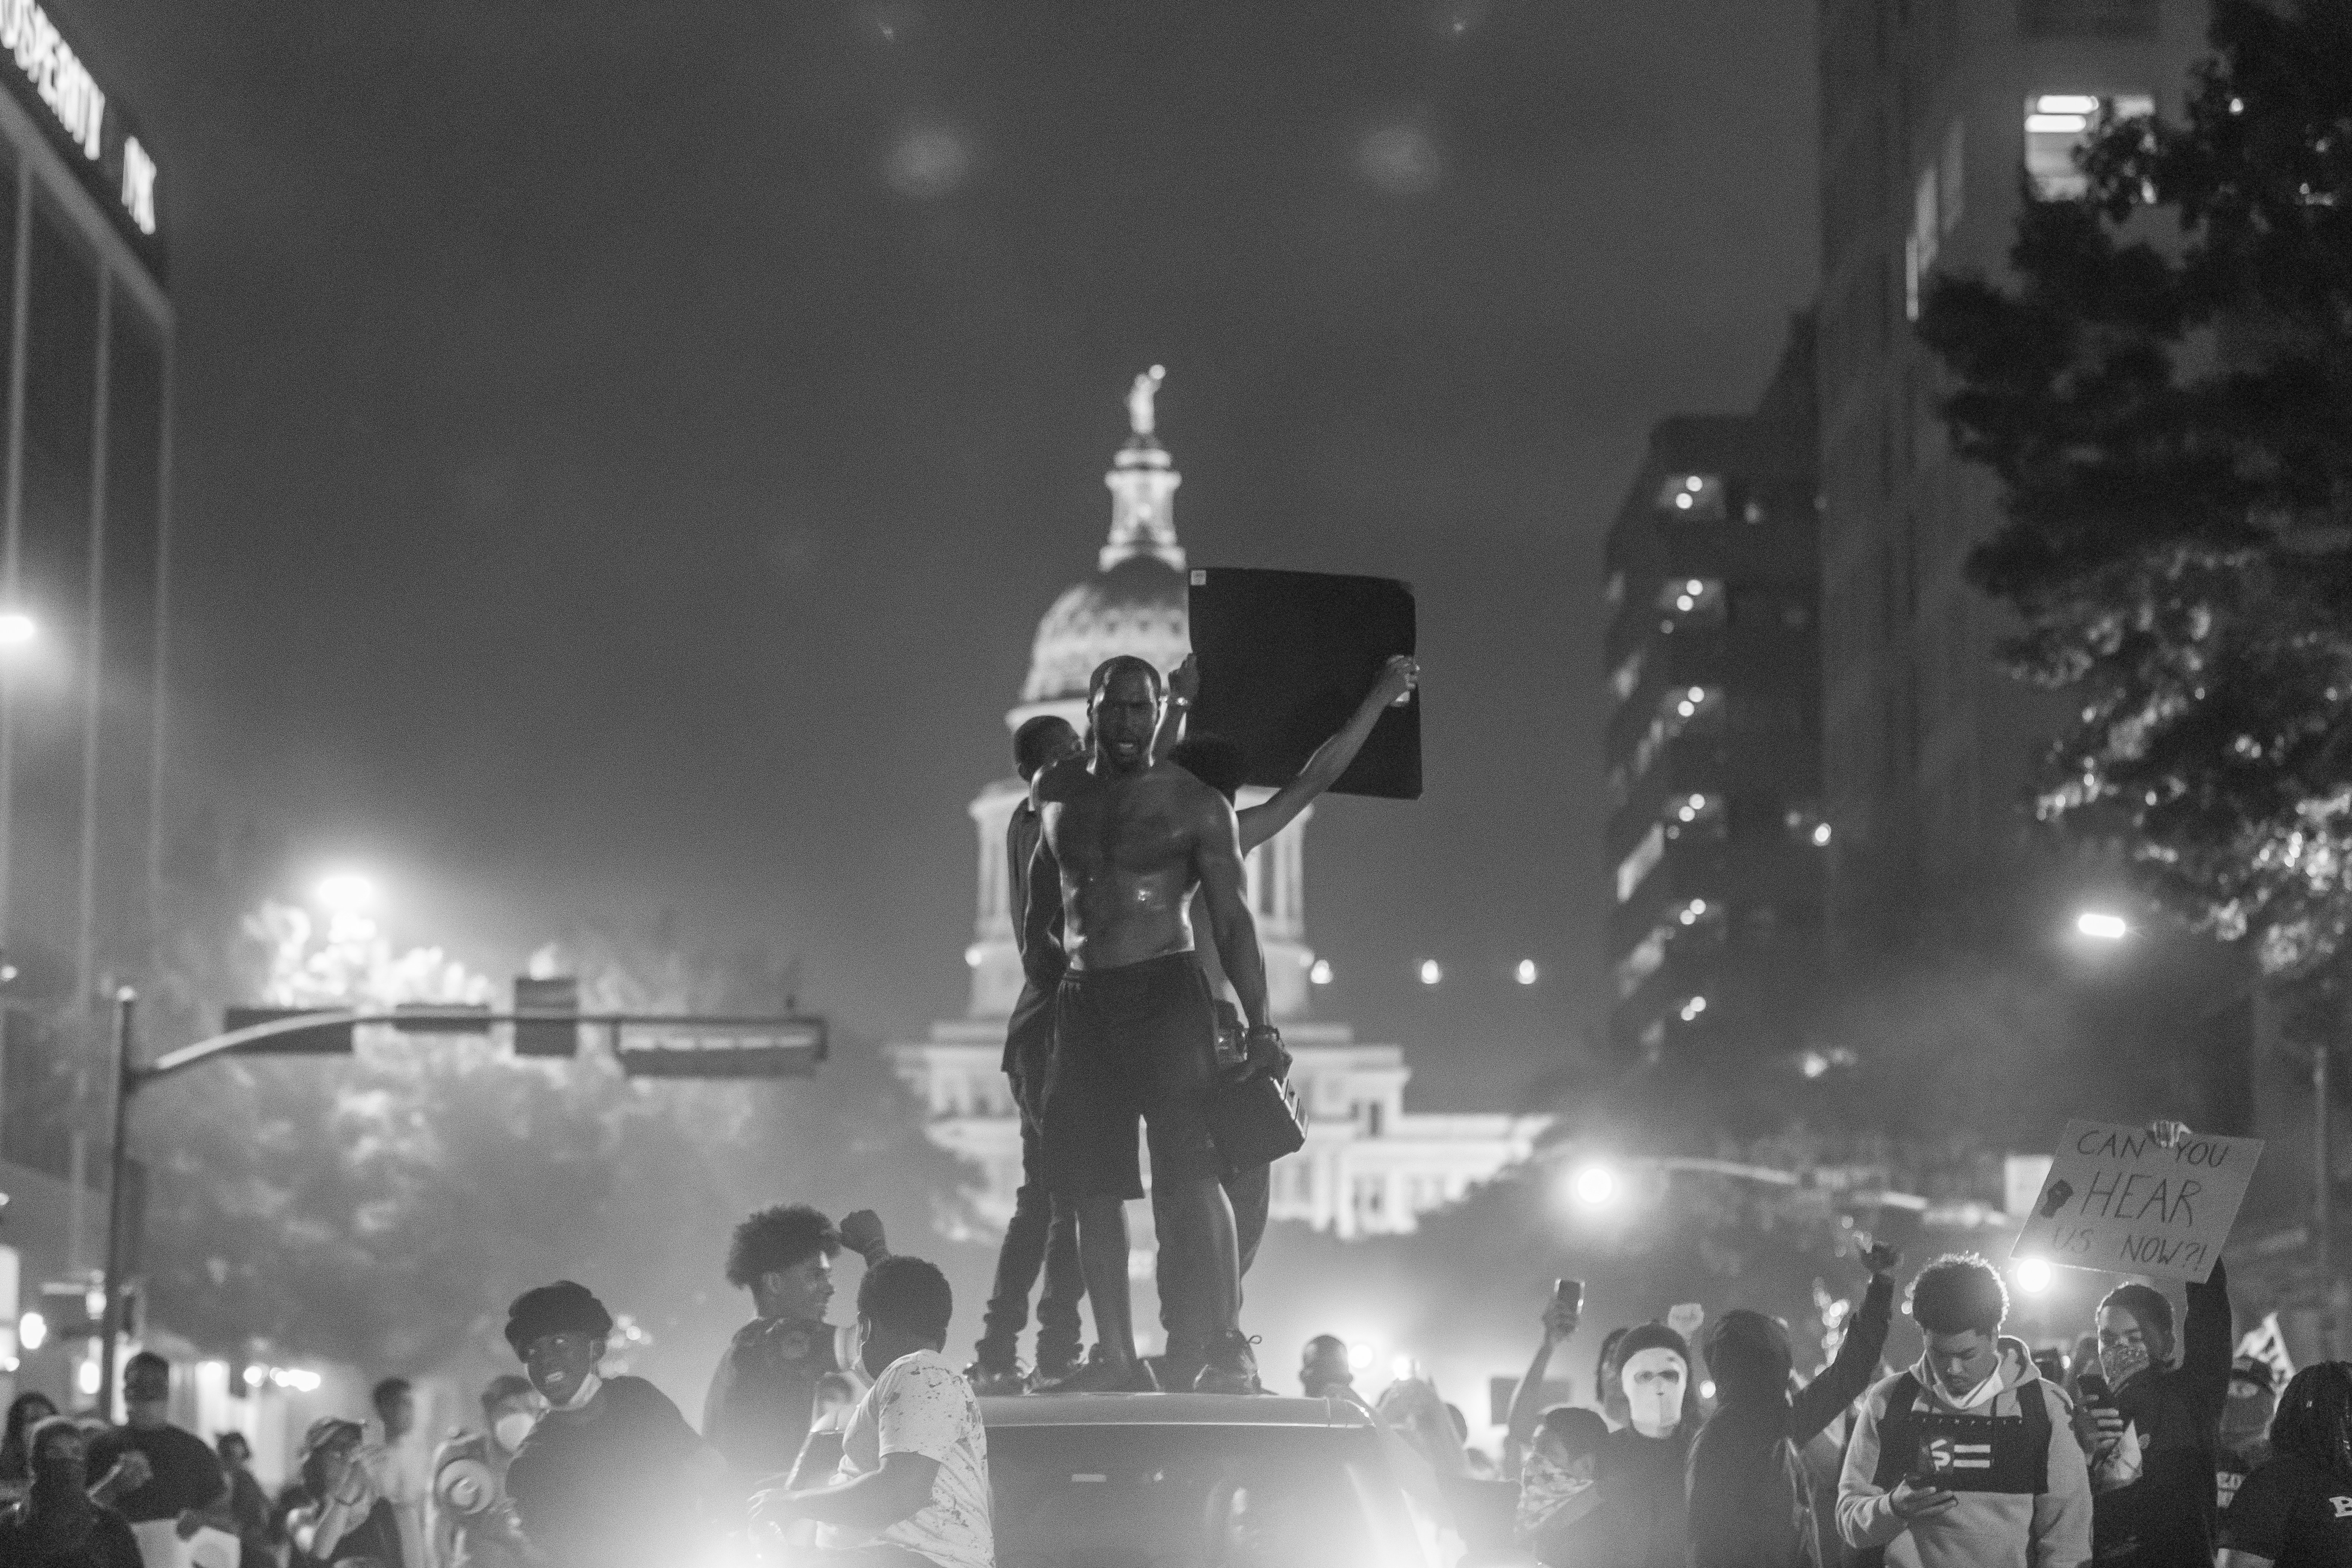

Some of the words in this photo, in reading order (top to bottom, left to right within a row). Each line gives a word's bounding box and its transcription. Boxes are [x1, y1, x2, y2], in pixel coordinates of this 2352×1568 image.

[2077, 1130, 2147, 1159] CAN
[2175, 1140, 2229, 1168] YOU
[2080, 1171, 2202, 1226] HEAR
[2053, 1227, 2094, 1253] US
[2119, 1234, 2208, 1271] NOW?!
